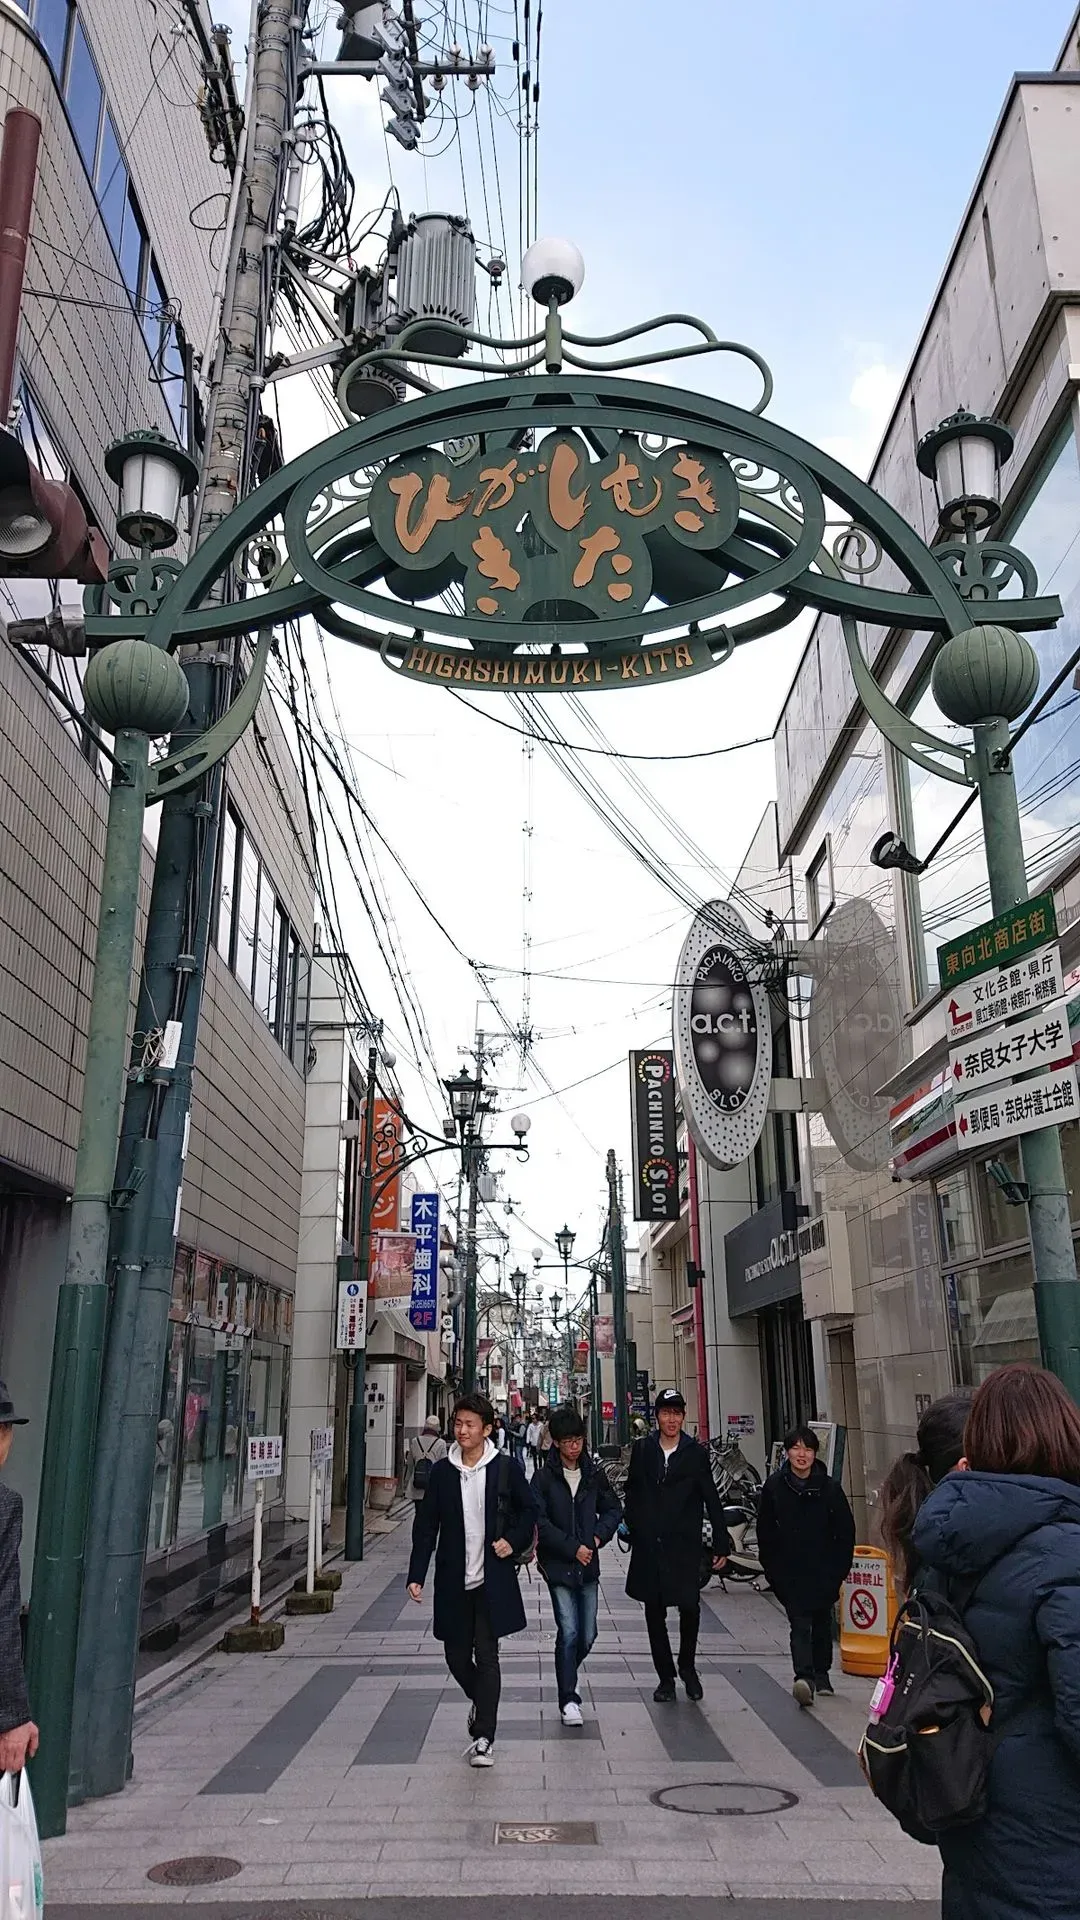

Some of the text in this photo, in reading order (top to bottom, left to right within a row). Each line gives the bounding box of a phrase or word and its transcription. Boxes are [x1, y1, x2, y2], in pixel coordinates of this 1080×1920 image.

[388, 443, 721, 554] ひがしむき
[472, 525, 633, 616] きた
[407, 646, 694, 684] HIGASHIMUKI-KITA
[696, 952, 744, 983] PACHINKO
[945, 908, 1046, 977] 東向北商店街
[691, 1008, 757, 1035] a.c.t.
[964, 1020, 1064, 1079] 奈良女子大学
[709, 1086, 749, 1108] SLOT
[645, 1064, 669, 1215] PACHINKO SLOT
[413, 1197, 434, 1296] 木平歯科
[413, 1312, 433, 1326] 2F
